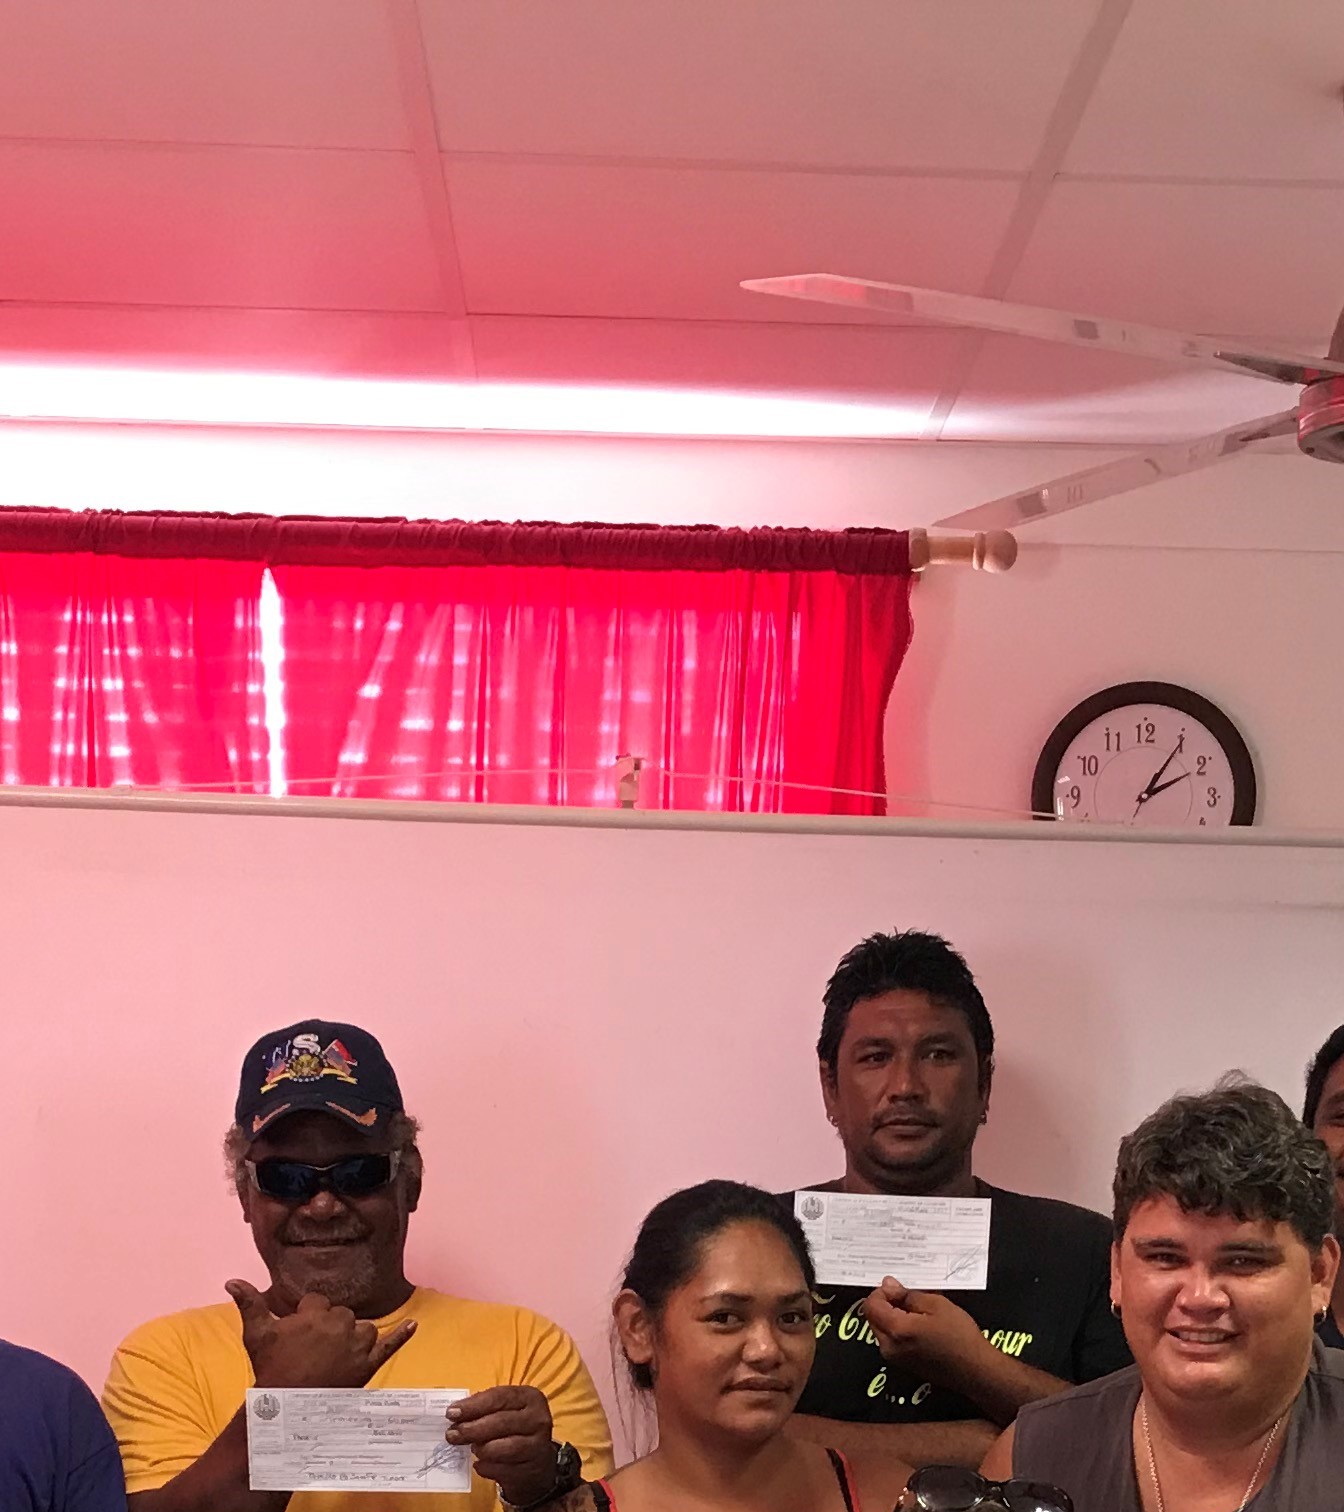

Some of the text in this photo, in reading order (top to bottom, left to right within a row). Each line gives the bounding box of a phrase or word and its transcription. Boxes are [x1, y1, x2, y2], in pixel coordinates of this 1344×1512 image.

[1104, 732, 1121, 751] 11
[1136, 723, 1156, 743] 12
[1081, 755, 1098, 775] 10
[1197, 755, 1207, 776] 2
[1070, 786, 1081, 807] 9
[1207, 787, 1217, 807] 3
